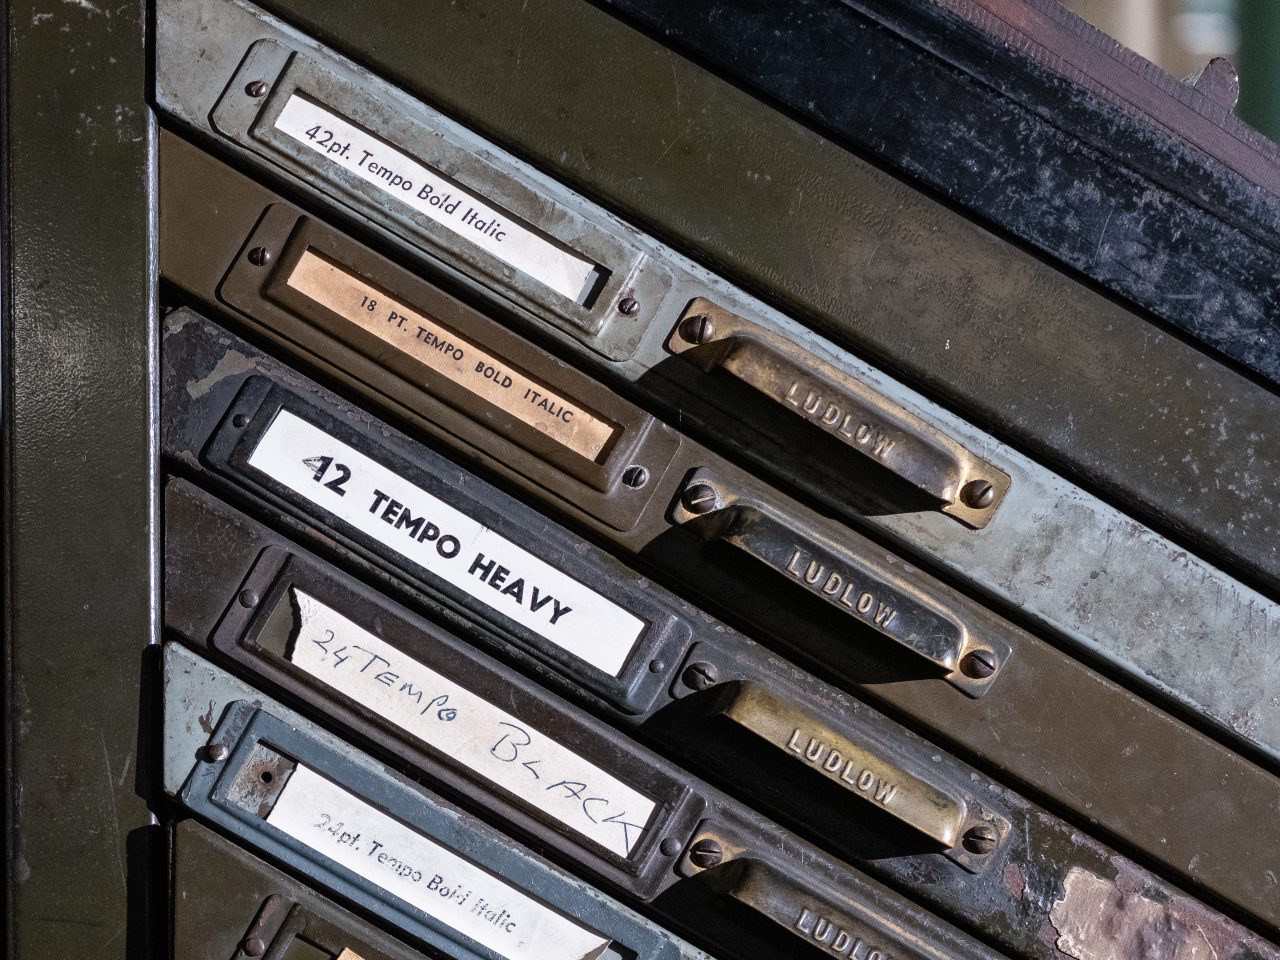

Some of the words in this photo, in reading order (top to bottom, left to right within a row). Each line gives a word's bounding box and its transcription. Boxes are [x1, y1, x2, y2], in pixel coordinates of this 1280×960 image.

[305, 124, 351, 161] 42pt.
[358, 149, 414, 193] Tempo
[416, 183, 462, 216] Bold
[461, 207, 507, 243] Italic
[359, 294, 378, 313] 18
[387, 310, 408, 333] PT.
[415, 326, 465, 361] TEMPO
[474, 360, 513, 390] BOLD
[523, 388, 574, 424] ITALIC
[785, 382, 897, 459] LUDLOW
[302, 454, 353, 498] 42
[368, 488, 461, 560] TEMPO
[468, 552, 573, 626] HEAVY
[785, 549, 897, 629] LUDLOW
[312, 629, 352, 669] 24
[489, 721, 649, 856] BLACK
[787, 728, 898, 806] LUDLOW
[311, 813, 361, 853] 24pt.
[367, 839, 423, 884] Tempo
[425, 873, 472, 907] Bold
[470, 897, 518, 935] Italic
